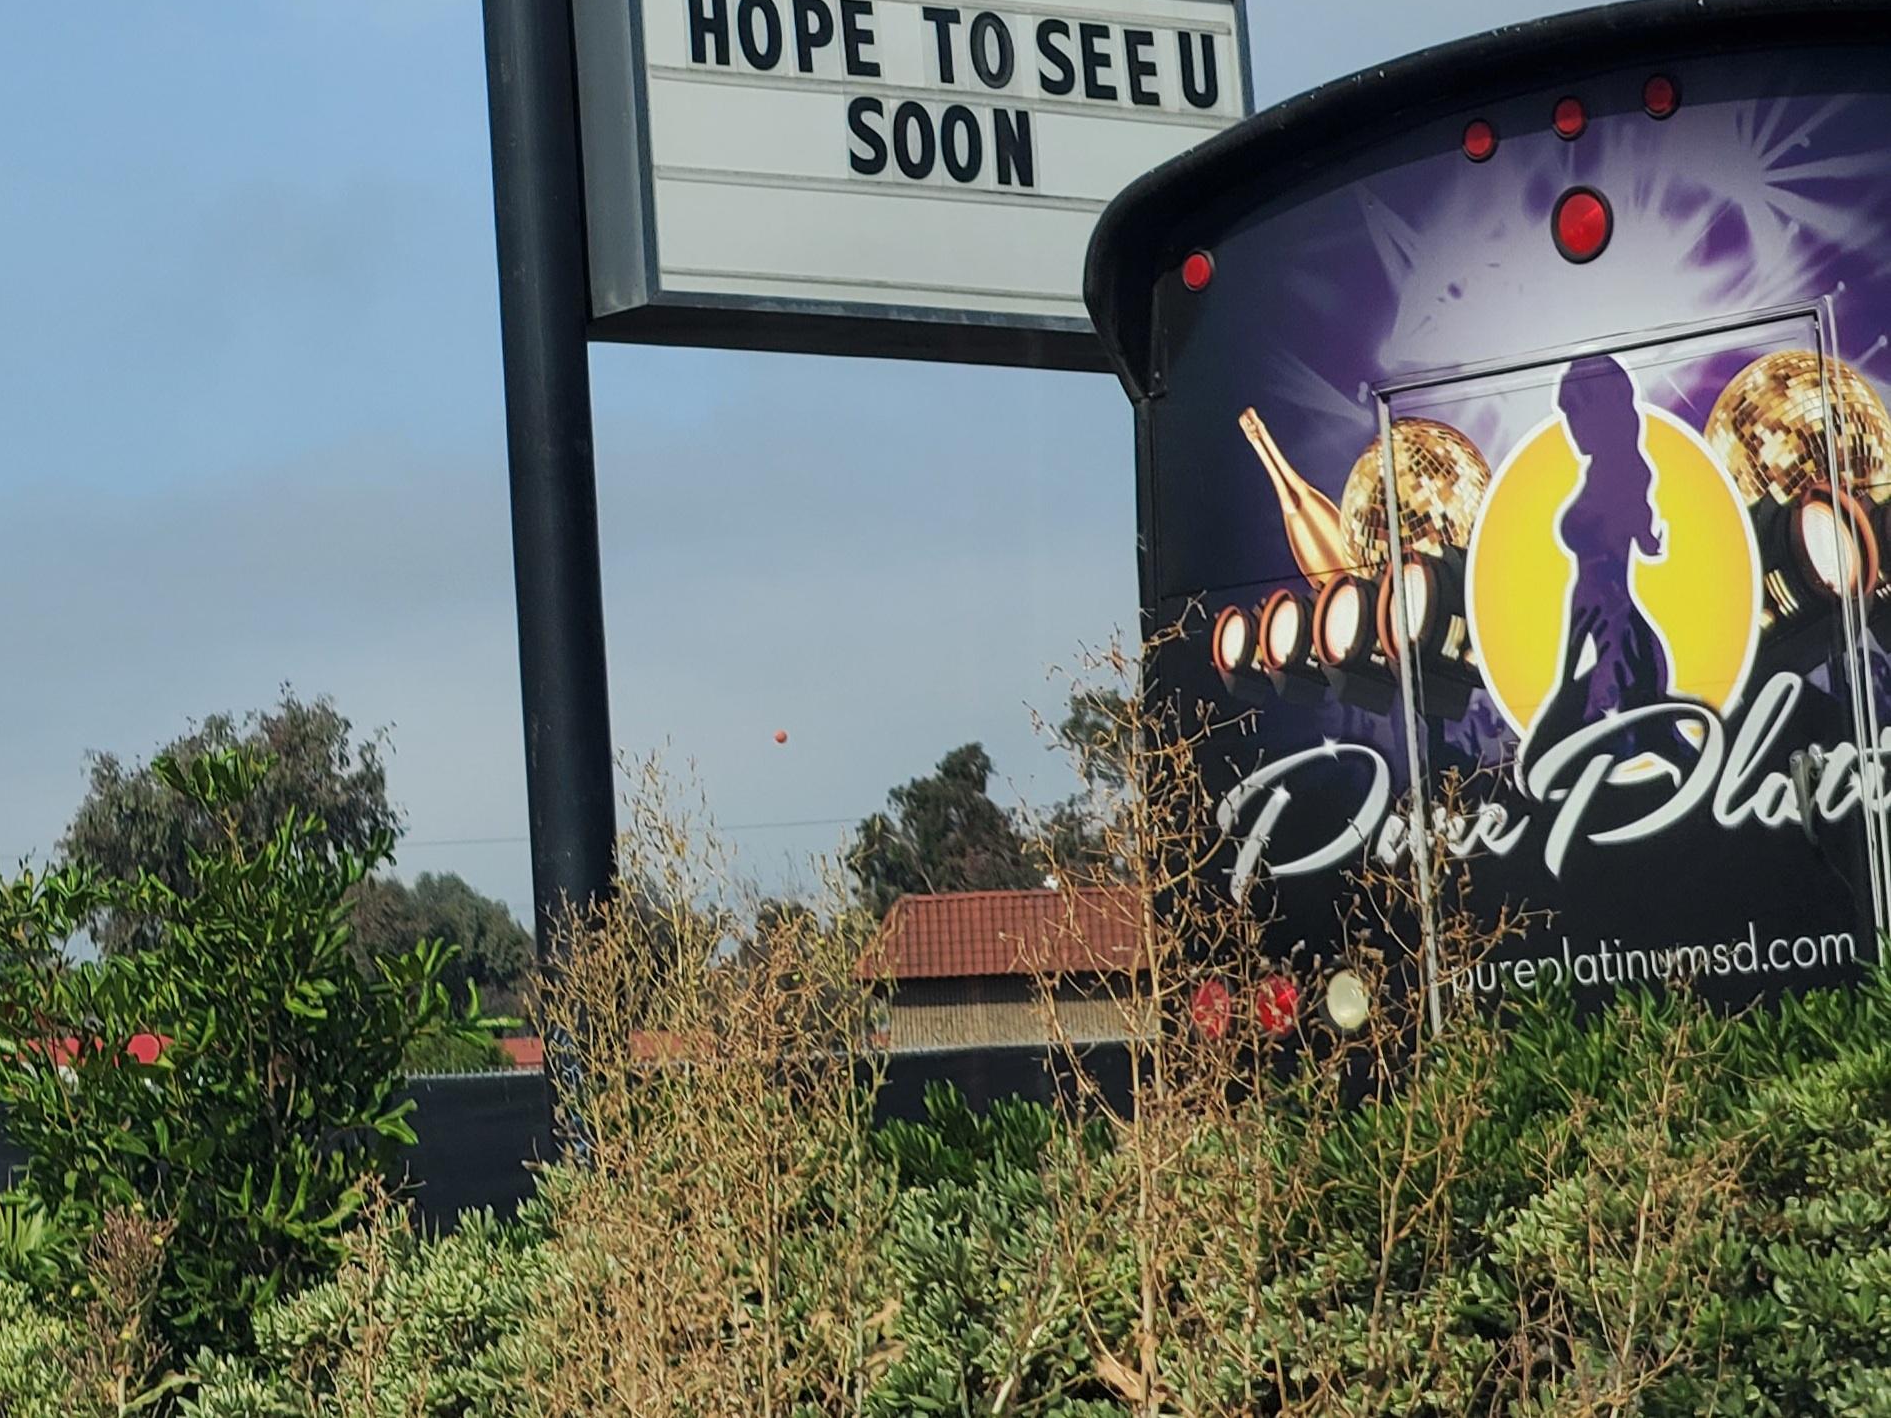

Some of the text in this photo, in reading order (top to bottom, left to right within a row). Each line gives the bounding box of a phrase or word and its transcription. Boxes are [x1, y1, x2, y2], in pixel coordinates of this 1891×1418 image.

[922, 5, 1015, 90] TO
[1035, 18, 1162, 108] SEE
[1178, 31, 1220, 110] U
[846, 96, 1036, 189] SOON
[1450, 921, 1857, 998] pureplatinumsd.com
